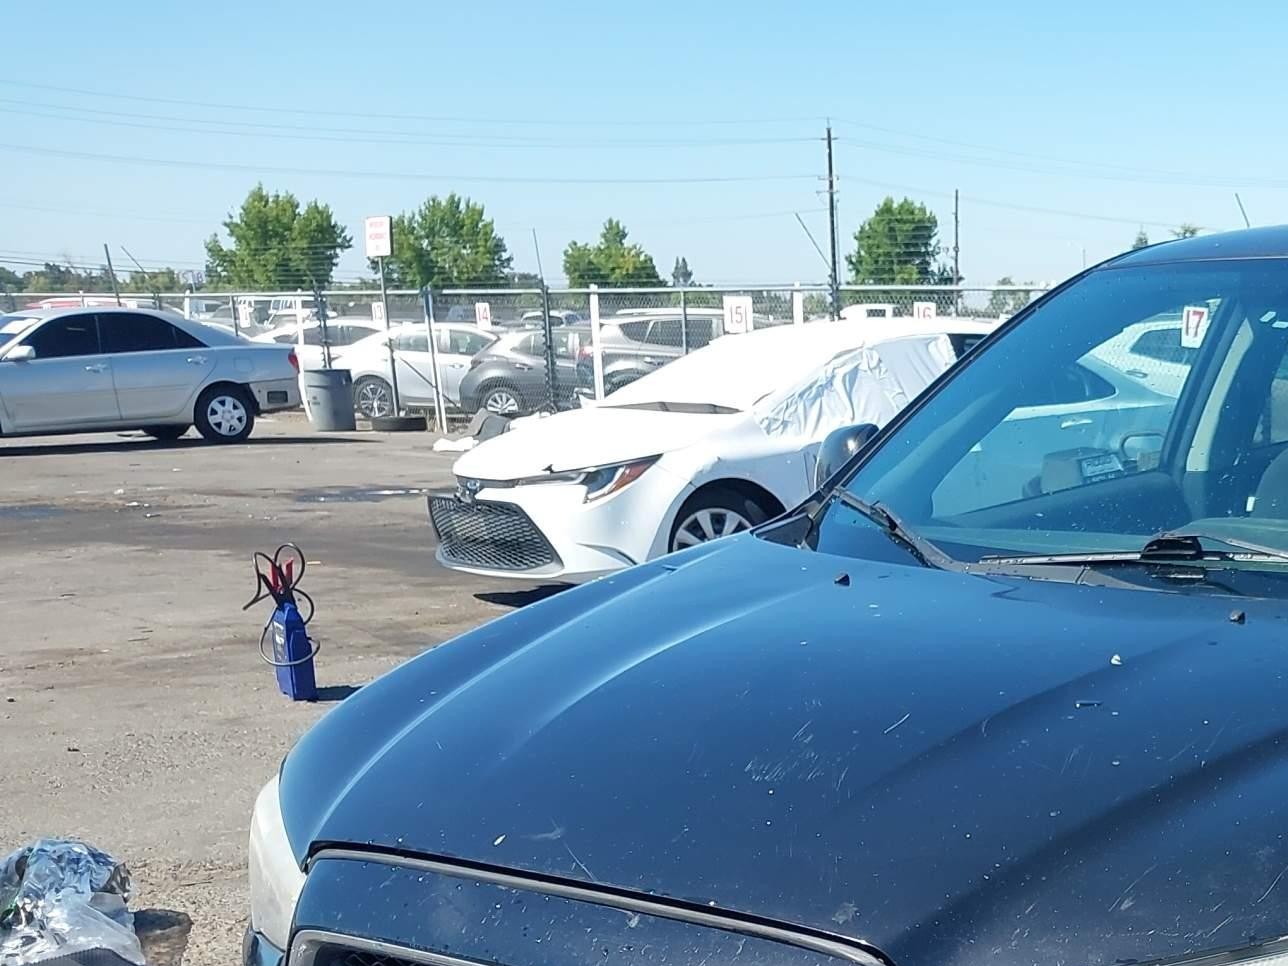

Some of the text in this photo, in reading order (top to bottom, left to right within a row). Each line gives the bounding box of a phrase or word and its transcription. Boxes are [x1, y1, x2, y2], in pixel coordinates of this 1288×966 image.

[478, 305, 488, 320] 14
[730, 304, 743, 323] 15
[1185, 310, 1204, 337] 17
